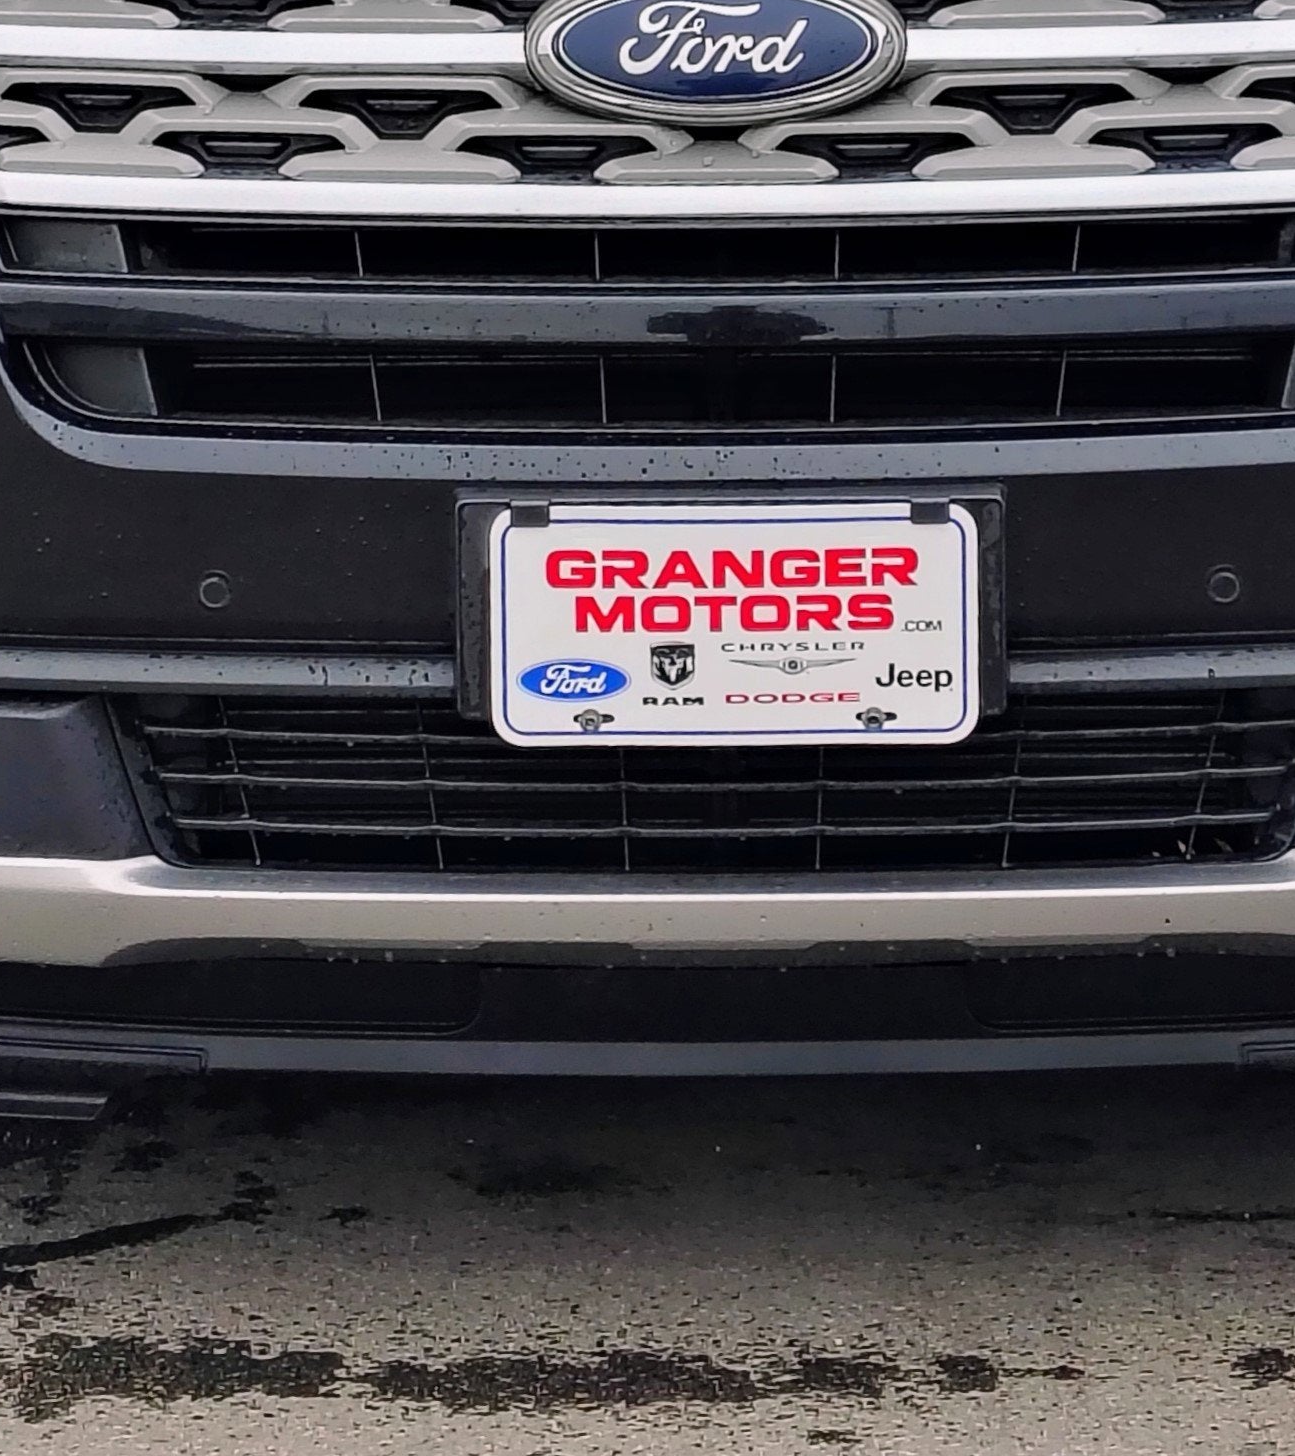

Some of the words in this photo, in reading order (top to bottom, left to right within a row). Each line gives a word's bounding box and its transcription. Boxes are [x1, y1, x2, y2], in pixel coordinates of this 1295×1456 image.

[618, 0, 809, 76] Ford
[545, 547, 919, 590] GRANGER
[573, 593, 896, 633] MOTORS
[720, 640, 865, 653] CHRYSLER
[540, 663, 608, 695] Ford
[875, 662, 954, 692] Jeep
[642, 696, 705, 706] RAM
[724, 692, 861, 704] DODGE
